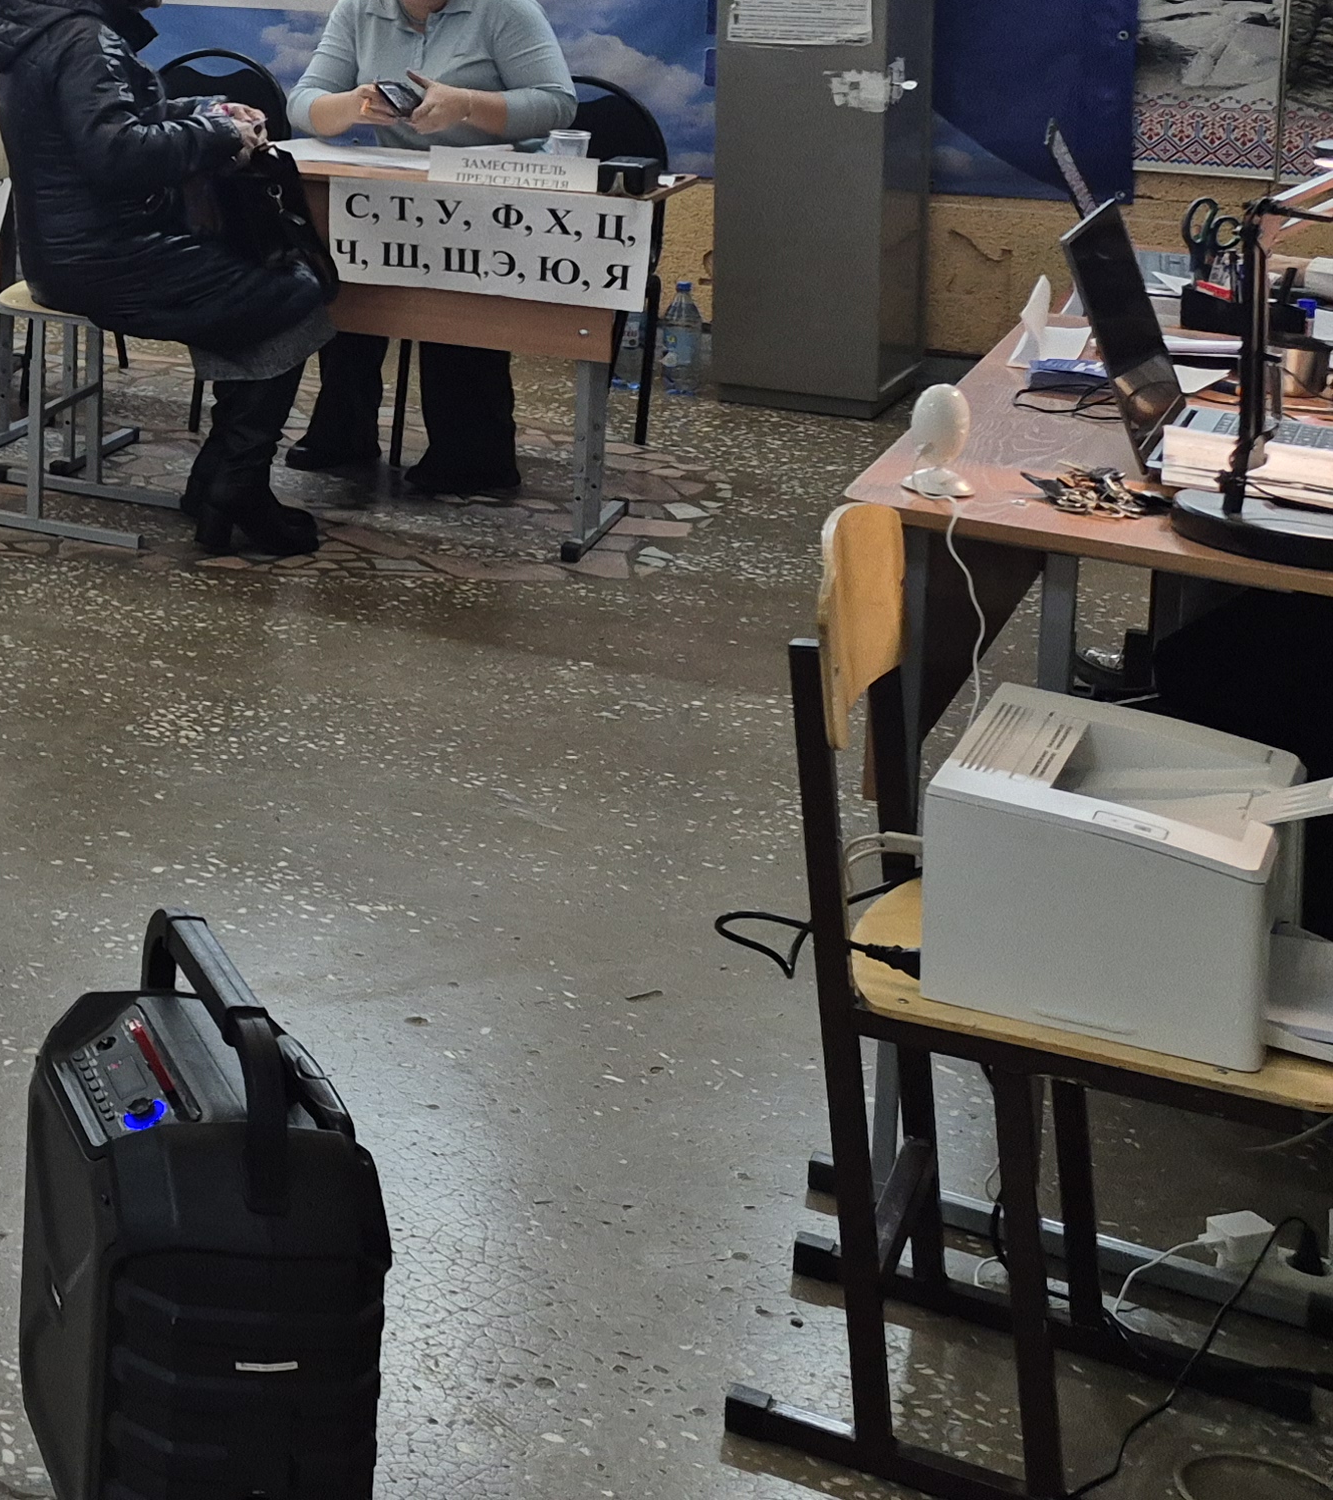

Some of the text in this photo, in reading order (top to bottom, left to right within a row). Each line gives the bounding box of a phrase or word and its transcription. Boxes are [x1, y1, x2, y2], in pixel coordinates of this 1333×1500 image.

[456, 171, 569, 190] ПРЕДСЕДАТЕЛЯ
[462, 157, 566, 176] ЗАМЕСТИТЕЛЬ
[345, 193, 636, 247] С, Т, У, Ф, Х, Ц,
[335, 239, 369, 270] Ч,
[381, 242, 430, 275] Ш,
[537, 256, 590, 292] Ю,
[602, 264, 631, 291] Я
